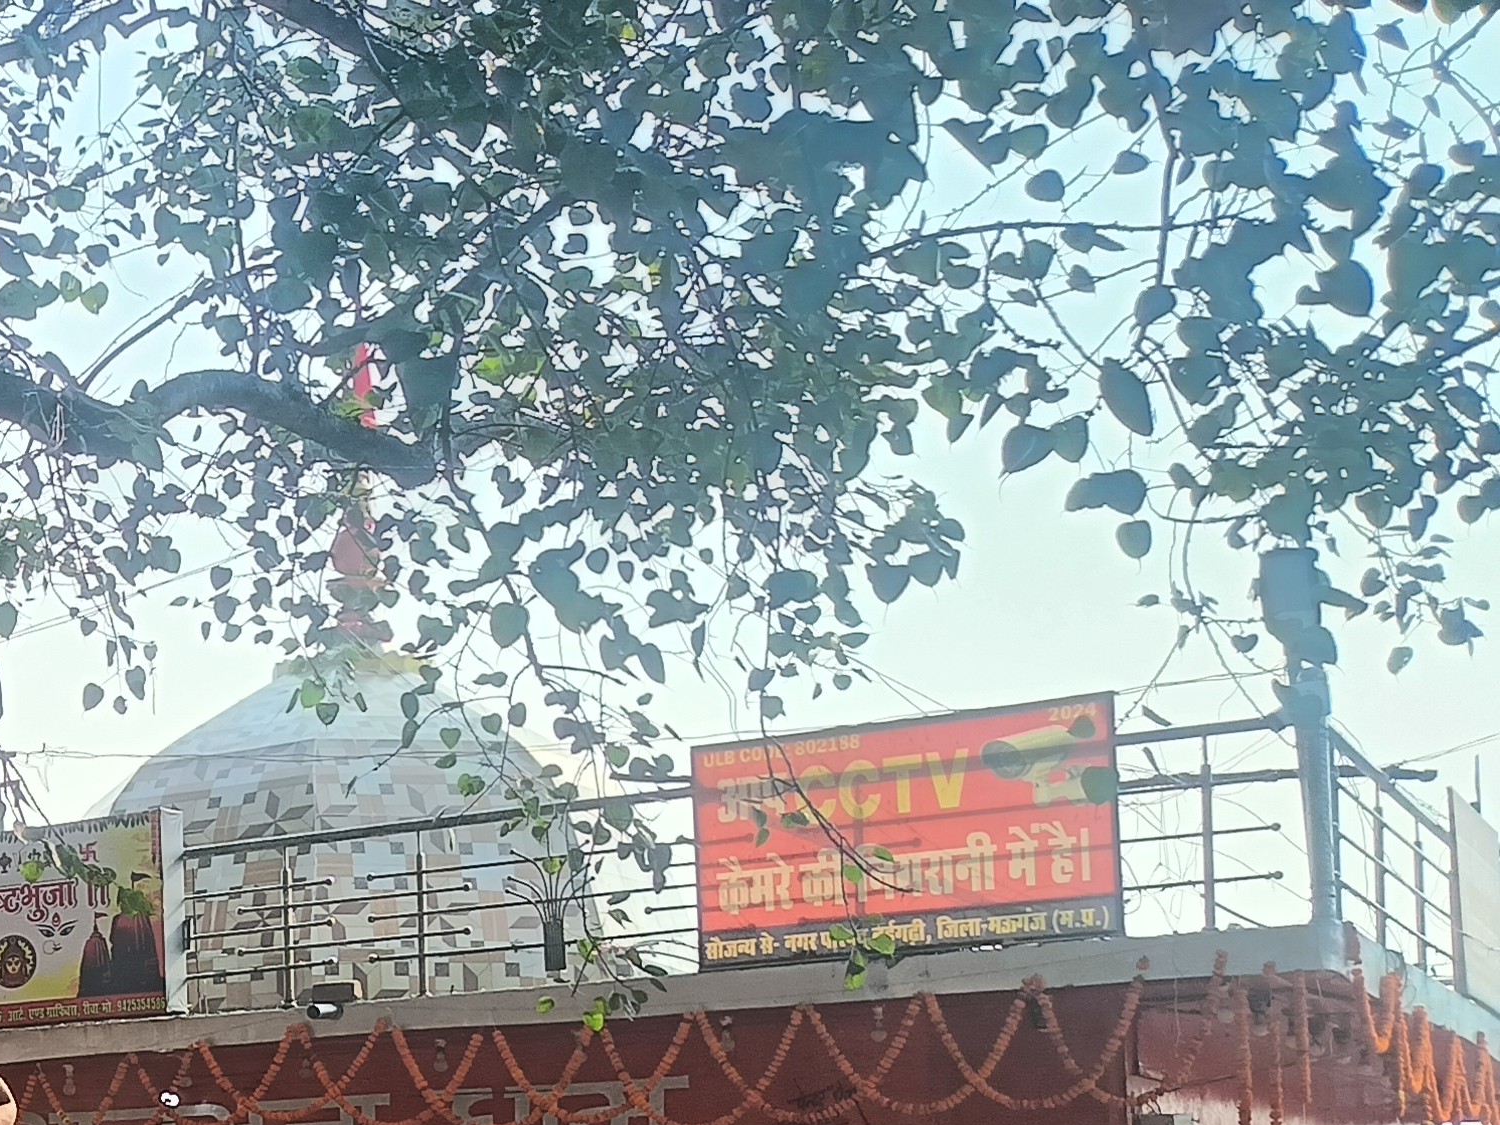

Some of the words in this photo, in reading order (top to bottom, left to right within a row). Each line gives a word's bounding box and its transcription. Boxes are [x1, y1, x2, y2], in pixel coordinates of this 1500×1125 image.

[703, 751, 735, 768] ULB
[795, 733, 860, 756] 802188
[795, 748, 969, 825] CCTV
[716, 852, 794, 916] कैमरे
[799, 848, 847, 907] की
[705, 936, 757, 960] सौजन्य
[784, 932, 819, 953] नगर
